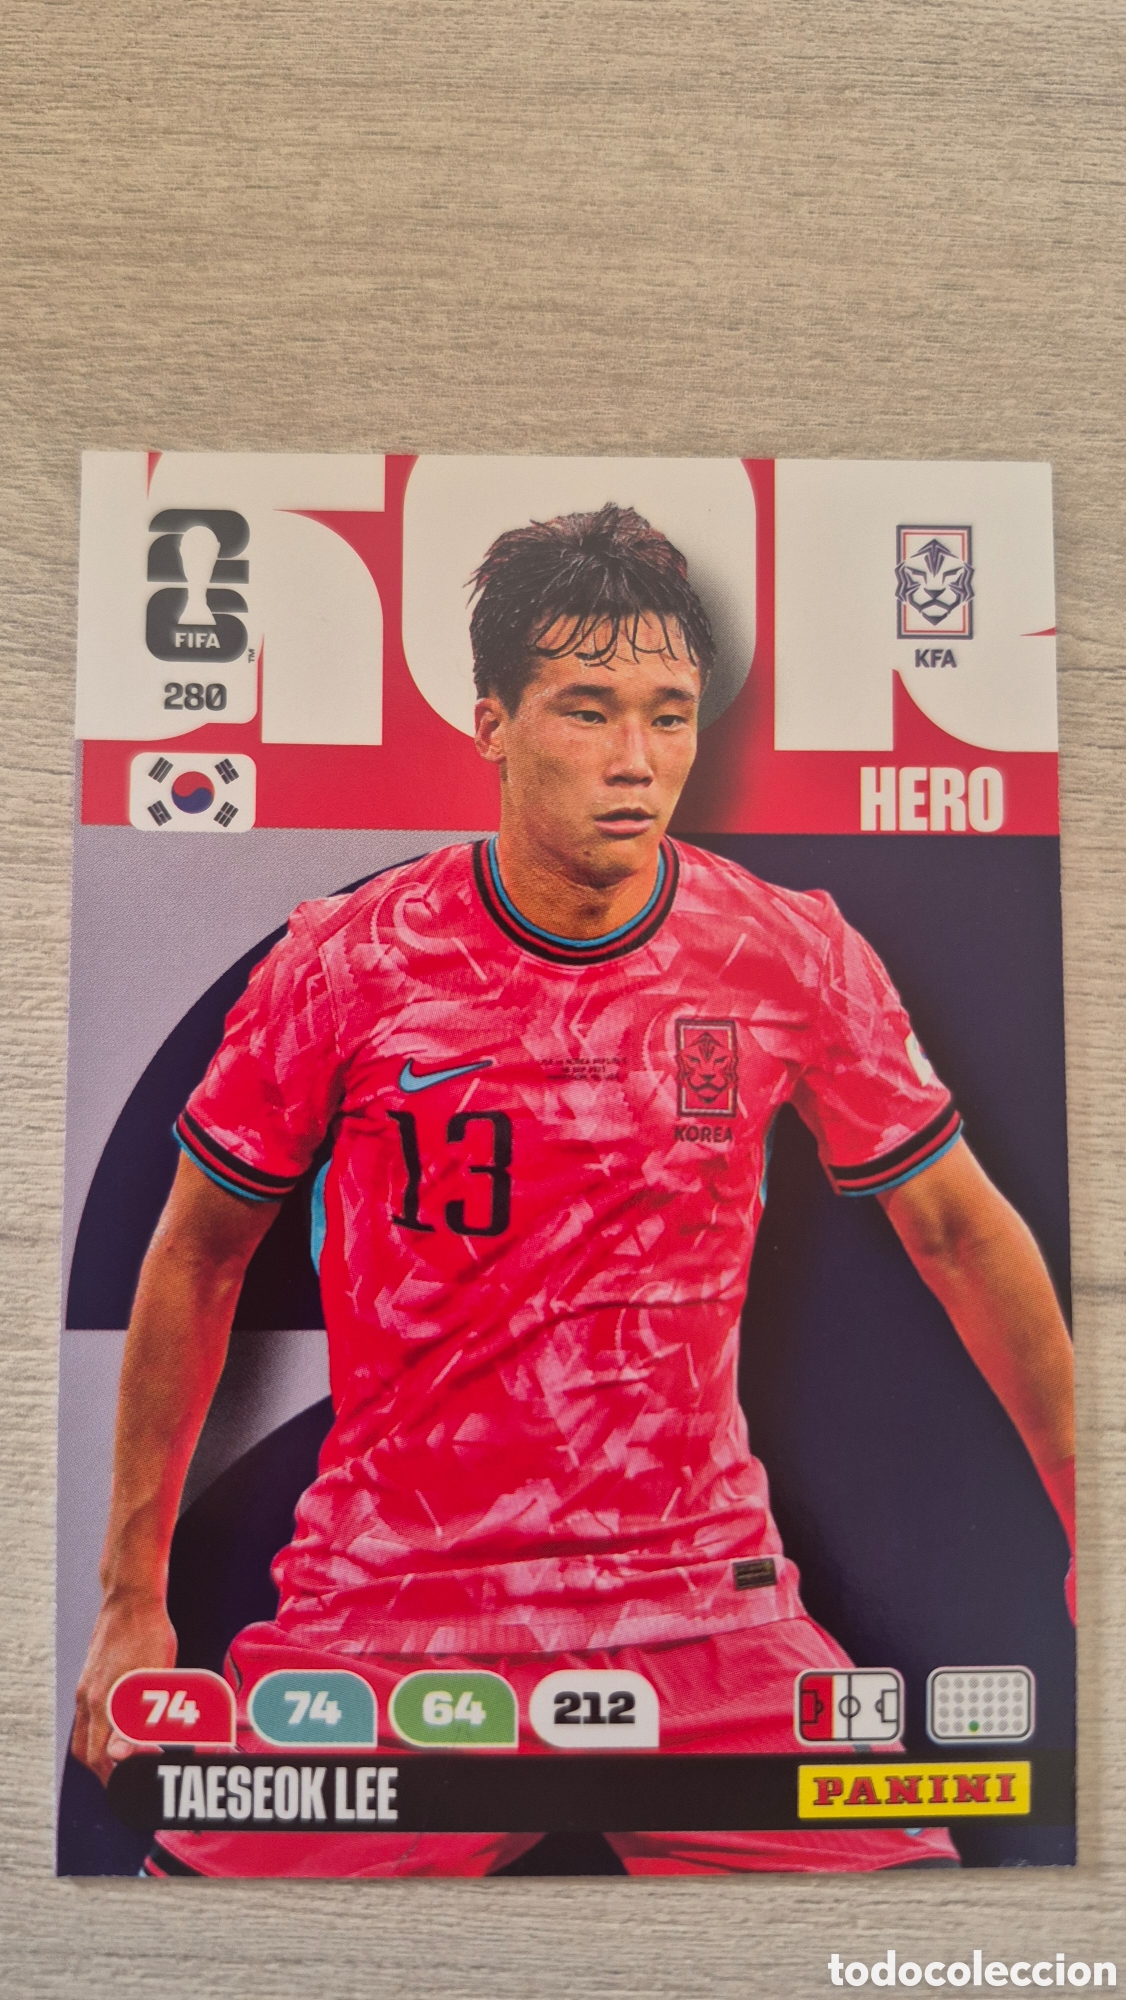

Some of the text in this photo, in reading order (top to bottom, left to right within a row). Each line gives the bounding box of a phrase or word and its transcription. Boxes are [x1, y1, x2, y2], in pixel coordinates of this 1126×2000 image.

[174, 632, 221, 649] FIFA
[914, 648, 957, 669] KFA
[163, 682, 228, 712] 280
[860, 766, 1004, 832] HERO
[673, 1124, 734, 1144] KOREA
[386, 1109, 513, 1238] 13
[141, 1689, 200, 1725] 74
[283, 1690, 342, 1726] 74
[422, 1690, 486, 1727] 64
[553, 1690, 636, 1725] 212
[157, 1764, 399, 1820] TAESEOK LEE
[812, 1772, 1017, 1807] PANINI
